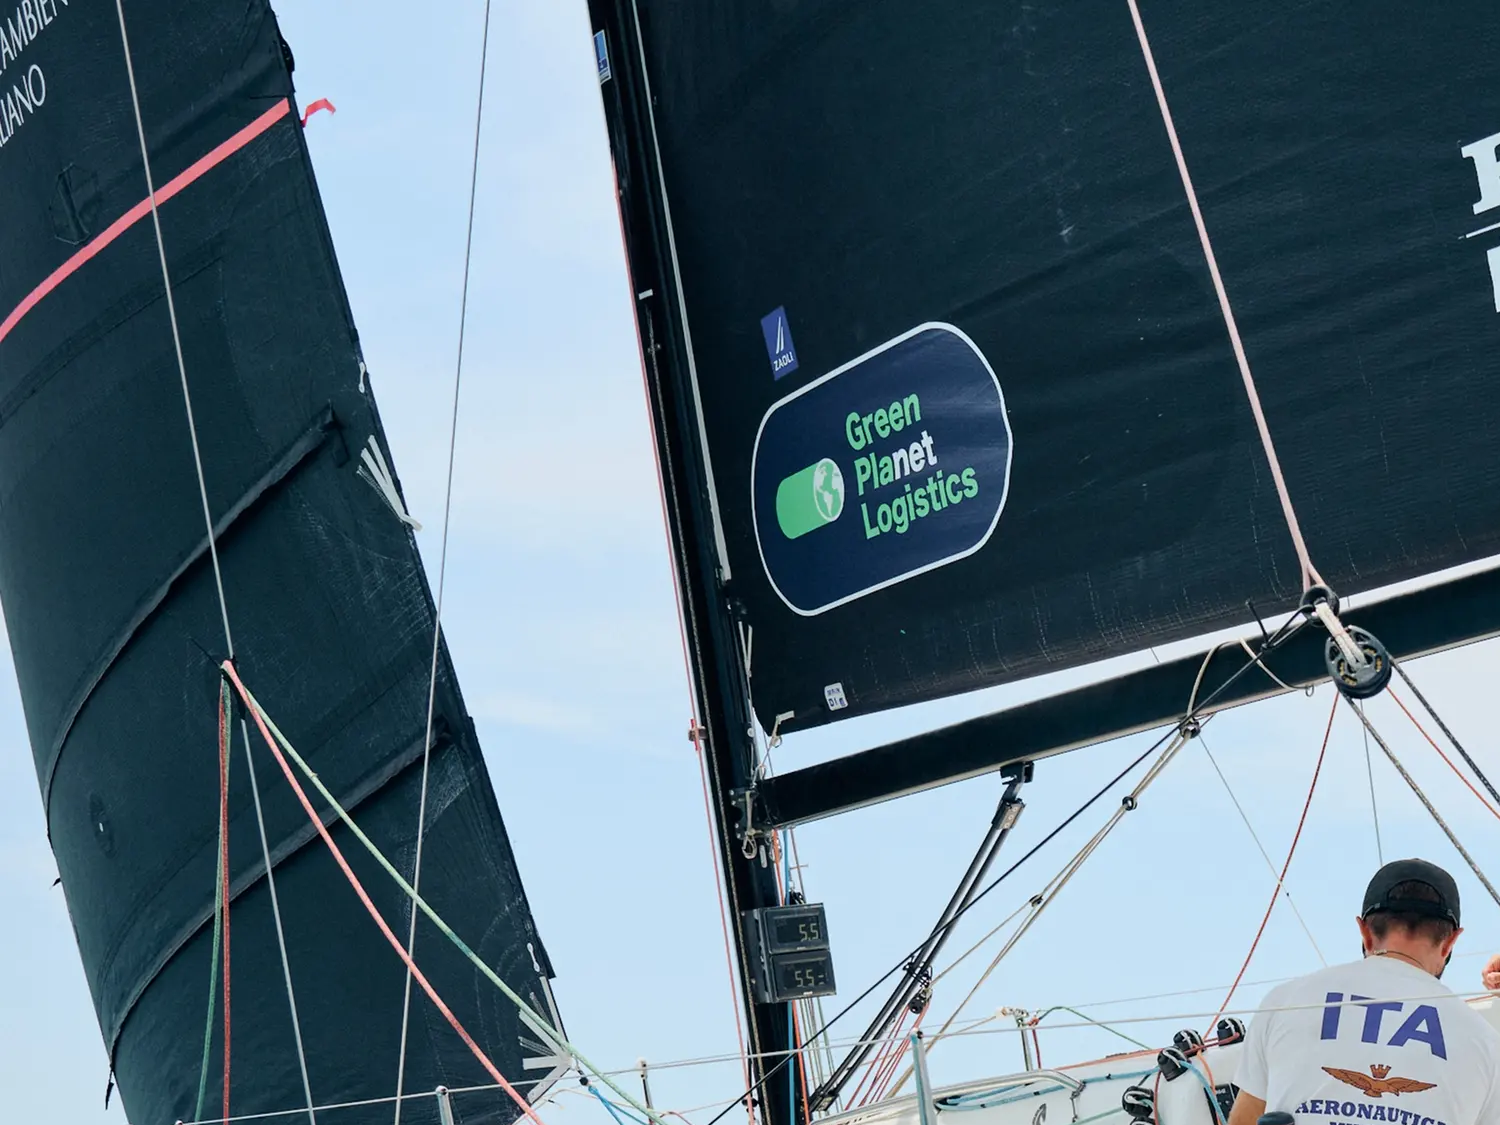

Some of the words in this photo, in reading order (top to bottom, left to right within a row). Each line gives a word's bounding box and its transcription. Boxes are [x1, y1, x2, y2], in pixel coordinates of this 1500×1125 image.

[0, 64, 46, 148] LIANO
[845, 392, 922, 451] Green
[853, 429, 939, 497] Planet
[860, 465, 979, 540] Logistics
[1320, 991, 1448, 1061] ITA
